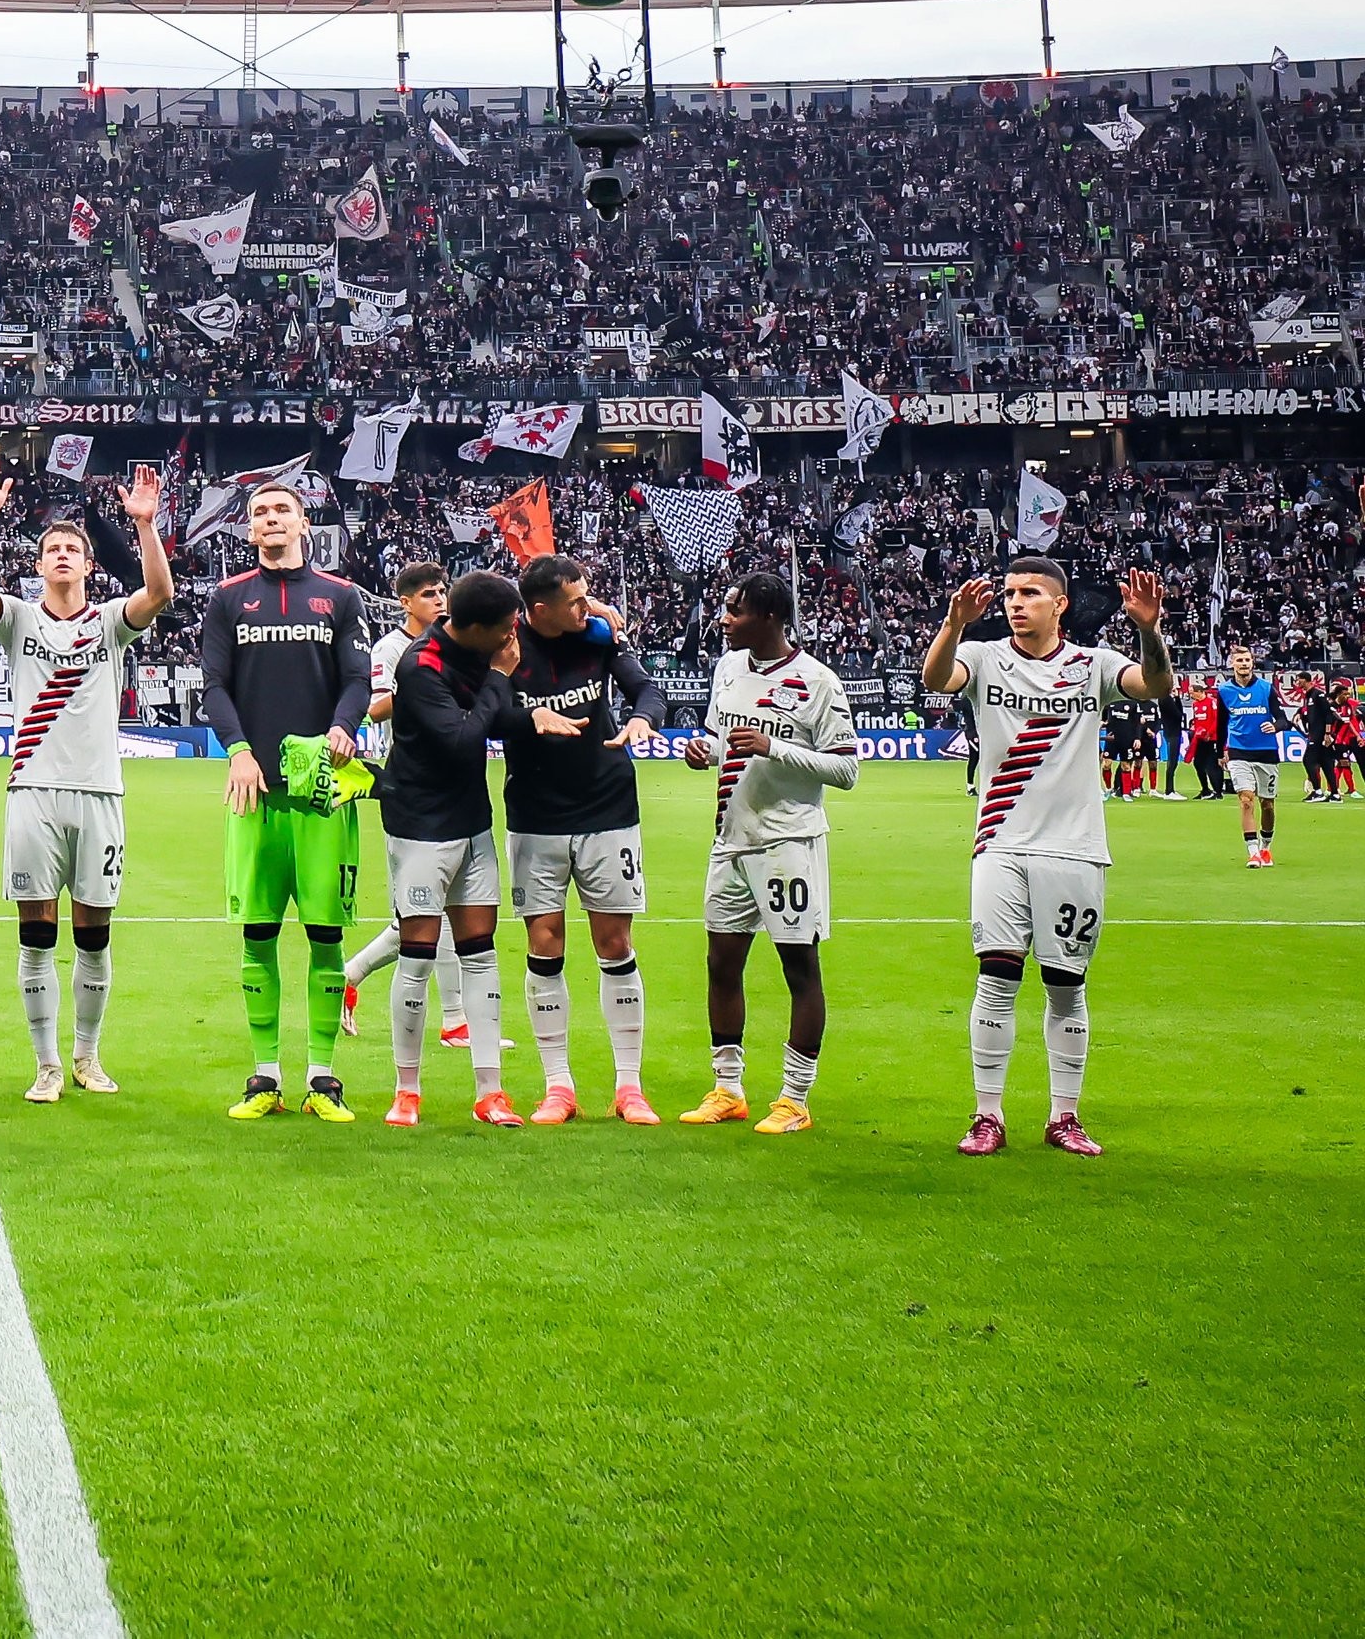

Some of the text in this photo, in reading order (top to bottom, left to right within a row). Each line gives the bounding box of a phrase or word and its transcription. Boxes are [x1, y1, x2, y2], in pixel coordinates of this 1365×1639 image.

[1286, 324, 1303, 335] 49
[38, 397, 137, 425] Szene
[770, 402, 846, 427] NASS
[1169, 388, 1299, 418] INFERNO
[236, 623, 334, 646] Barmenia
[22, 635, 109, 666] Barmenia
[653, 670, 704, 678] ULTRAS
[986, 684, 1098, 713] Barmenia
[717, 710, 794, 740] armenia
[855, 711, 926, 730] findn
[857, 733, 927, 760] port
[310, 746, 334, 815] menia
[768, 878, 809, 913] 30
[1054, 903, 1098, 945] 32
